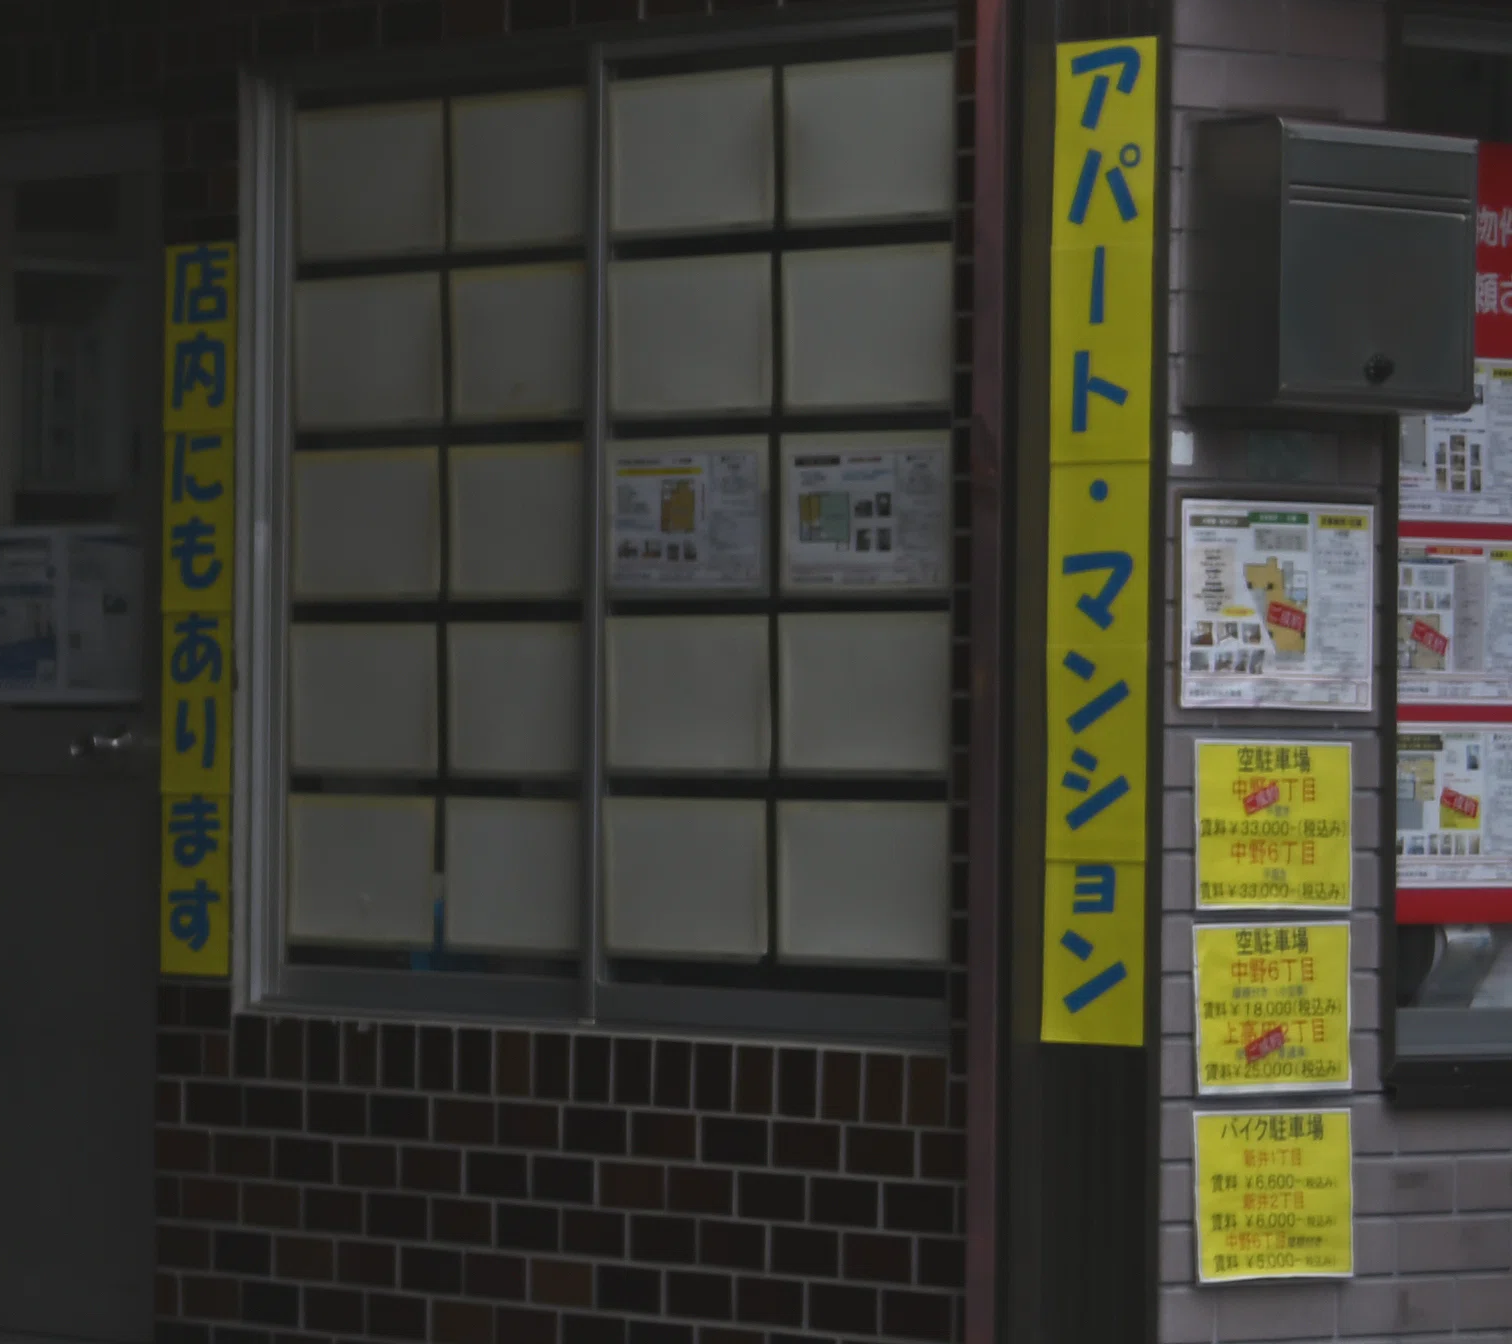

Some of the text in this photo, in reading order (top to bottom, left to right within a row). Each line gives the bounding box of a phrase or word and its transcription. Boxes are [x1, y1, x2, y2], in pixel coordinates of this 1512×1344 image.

[1060, 45, 1142, 1014] アパート・マンション
[168, 246, 232, 954] 店内にもあります
[1237, 746, 1311, 773] 空駐車場
[1231, 839, 1315, 866] 中野6丁目
[1235, 927, 1309, 955] 空駐車場
[1231, 956, 1314, 984] 中野6丁目
[1221, 1114, 1324, 1141] バイク駐車場
